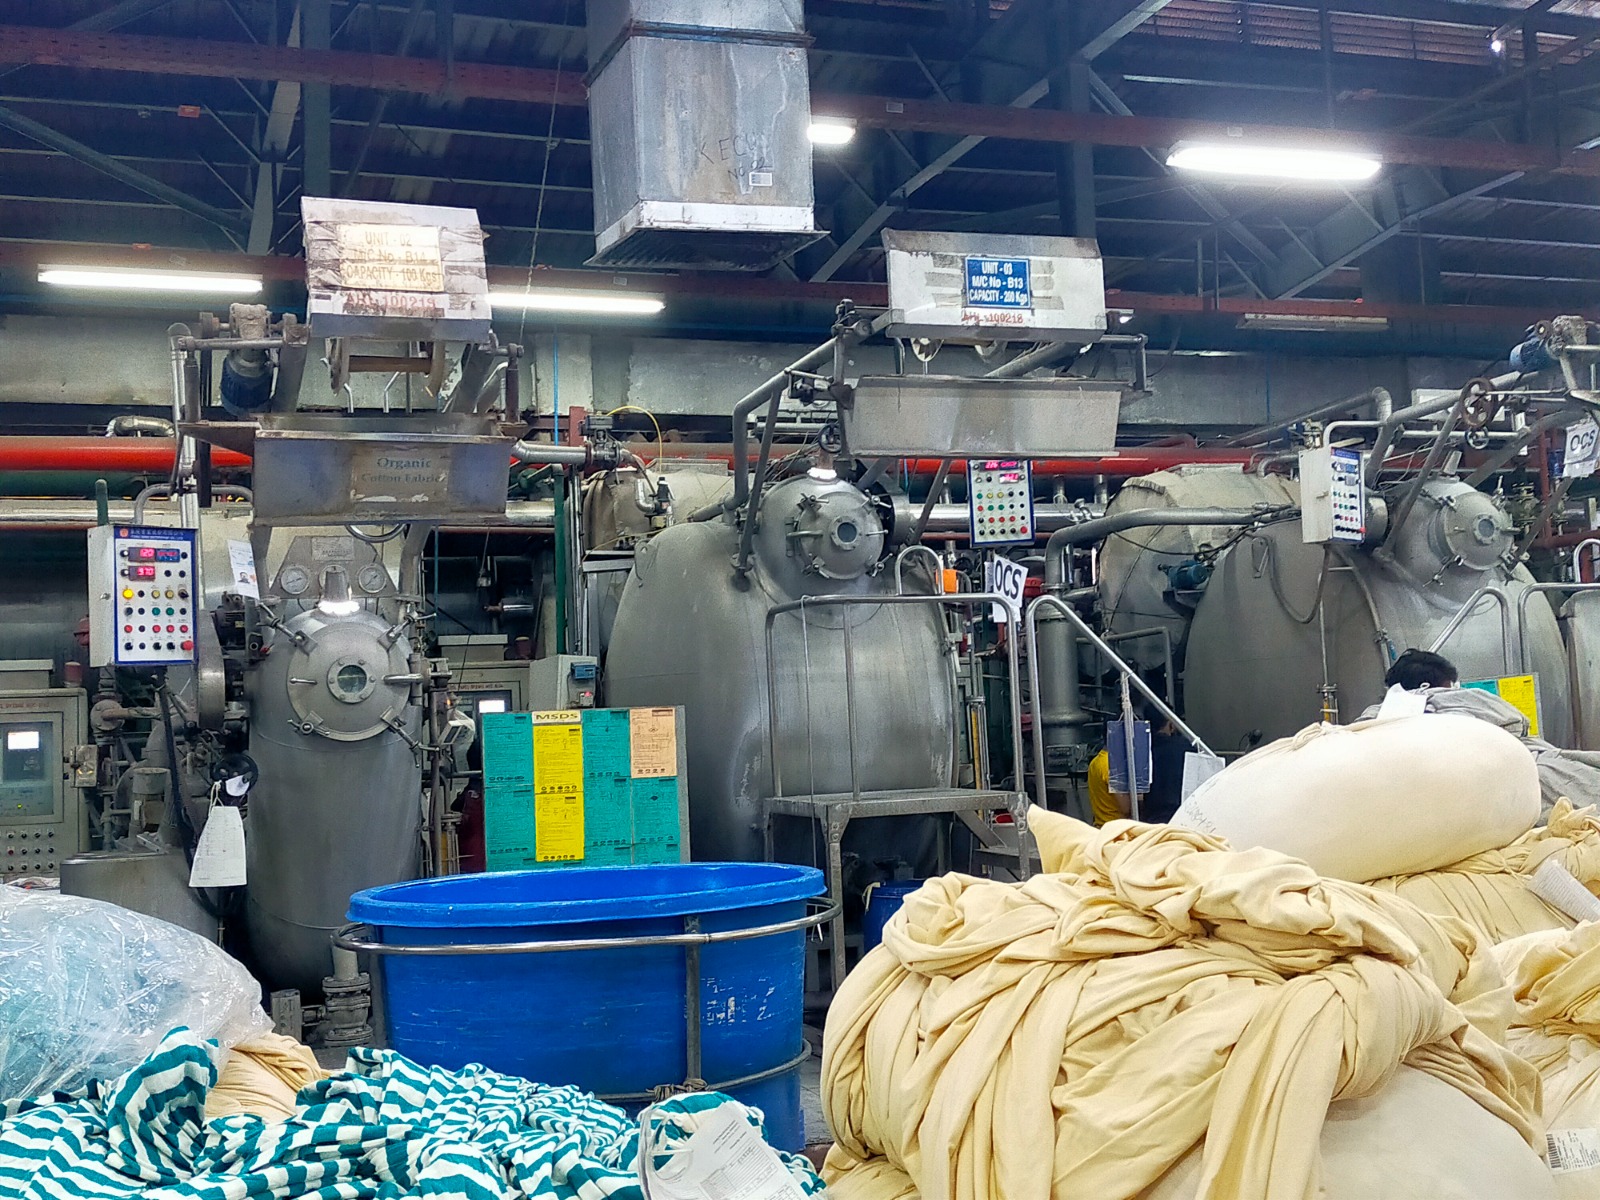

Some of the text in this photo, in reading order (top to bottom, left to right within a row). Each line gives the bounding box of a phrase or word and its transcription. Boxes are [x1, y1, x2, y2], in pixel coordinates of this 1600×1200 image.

[365, 231, 389, 246] UNIT
[346, 264, 393, 280] CAPACITY
[982, 261, 999, 274] UNIT
[1003, 262, 1013, 275] 03
[989, 276, 1001, 288] No
[1007, 277, 1023, 289] B13
[969, 289, 1000, 302] CAPACITY
[1570, 430, 1596, 451] OCS
[376, 458, 432, 470] Organic
[361, 473, 401, 483] Cotton
[995, 560, 1022, 599] OCS
